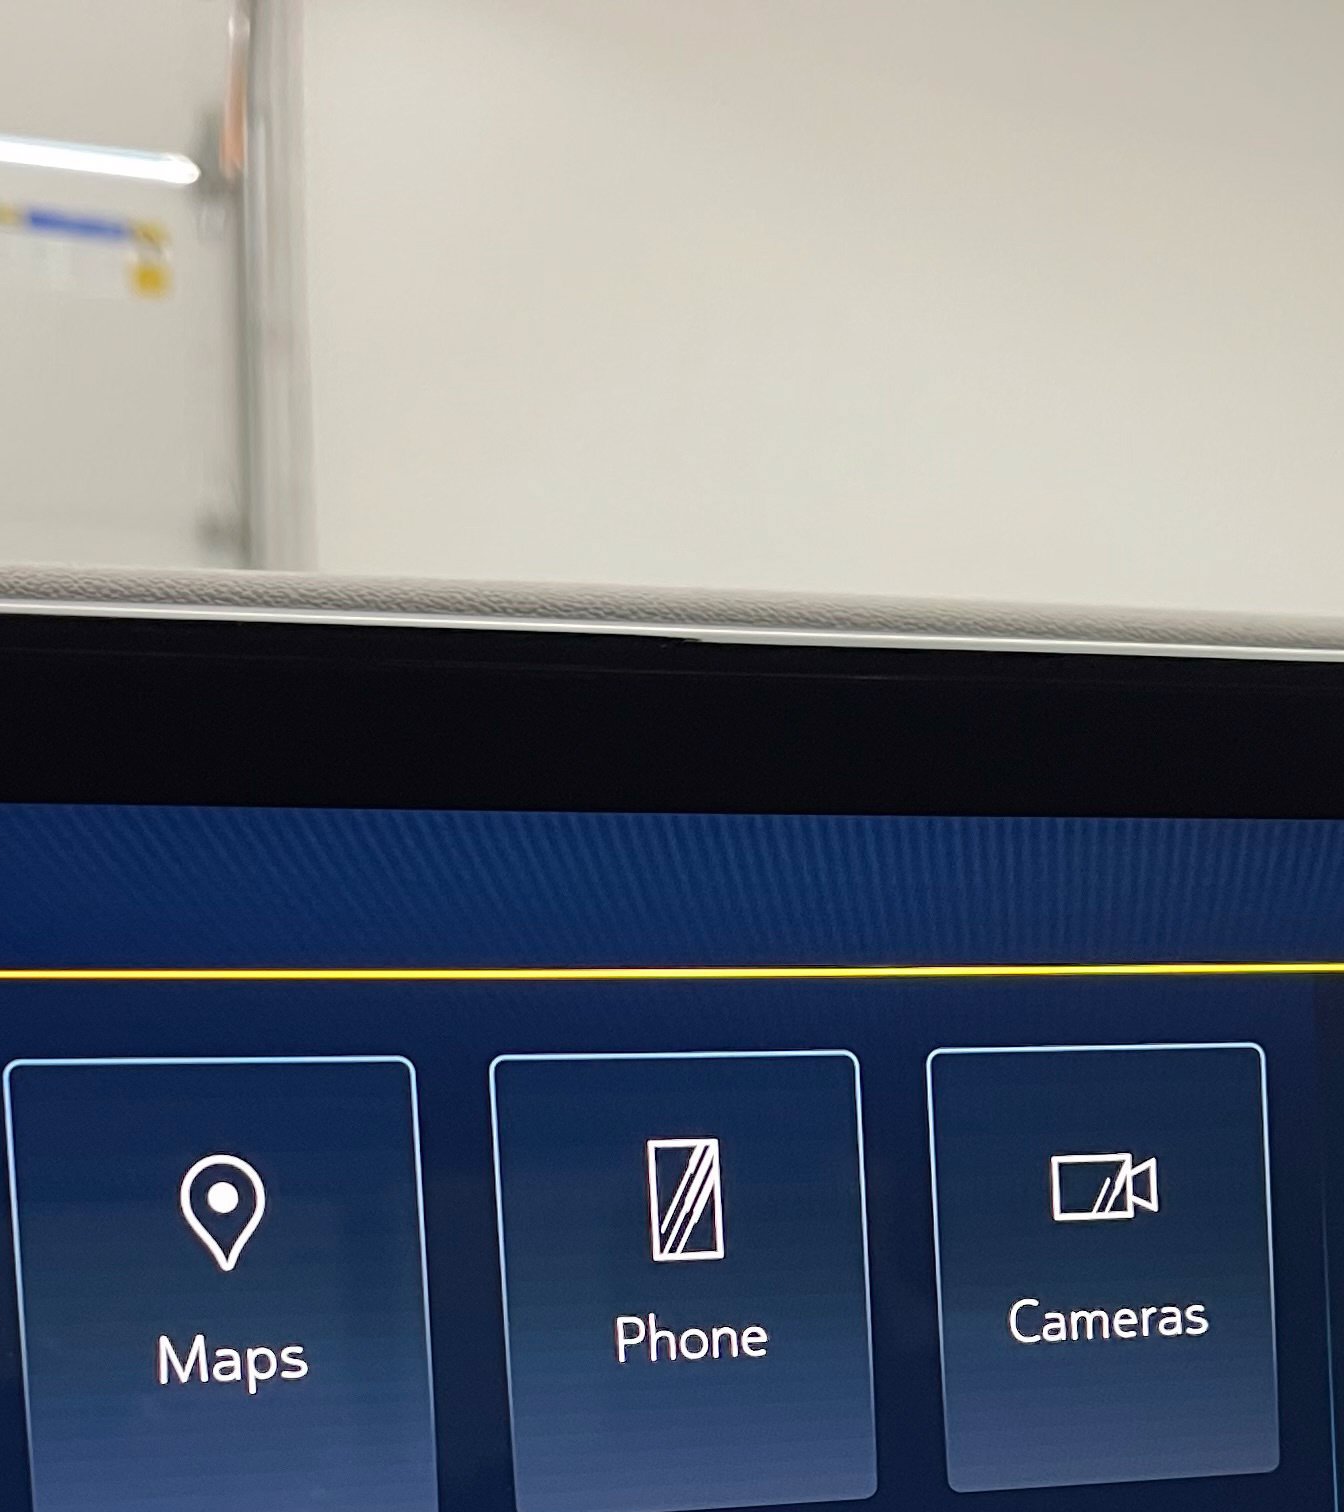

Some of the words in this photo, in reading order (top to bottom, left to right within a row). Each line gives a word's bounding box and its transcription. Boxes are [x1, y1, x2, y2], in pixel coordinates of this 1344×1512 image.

[615, 1311, 769, 1364] Phone
[1008, 1297, 1210, 1344] Cameras
[158, 1333, 310, 1396] Maps
